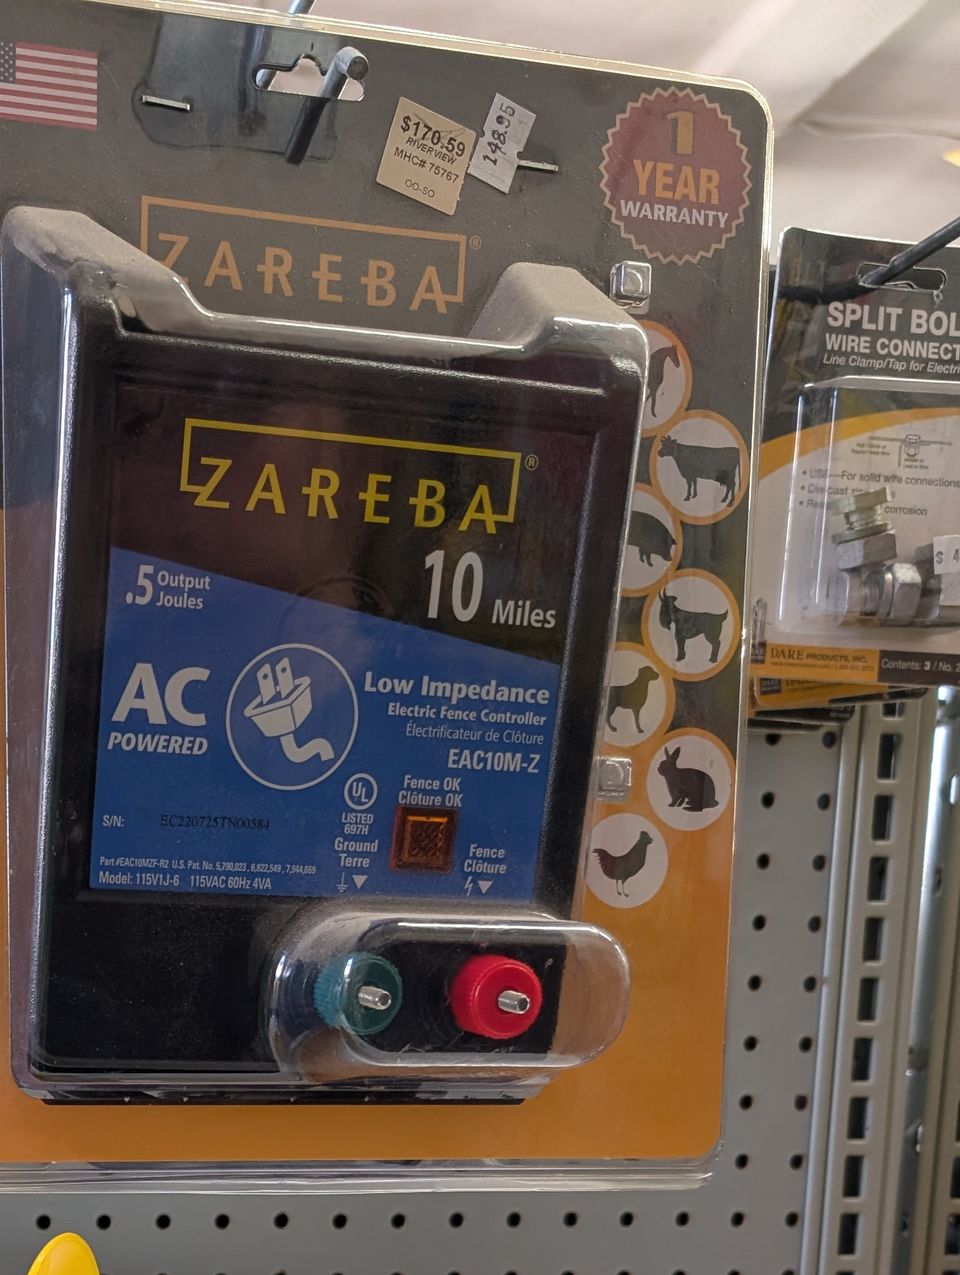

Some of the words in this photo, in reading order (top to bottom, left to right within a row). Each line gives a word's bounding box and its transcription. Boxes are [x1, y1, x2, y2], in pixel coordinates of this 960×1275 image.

[401, 115, 466, 157] $170.59
[665, 110, 695, 155] 1
[406, 137, 457, 165] RIVERVIEW
[394, 147, 427, 168] MHC#
[429, 163, 460, 184] 75767
[633, 159, 720, 205] YEAR
[620, 200, 729, 228] WARRANTY
[158, 232, 448, 314] ZAREBA
[827, 301, 902, 331] SPLIT
[825, 333, 871, 353] WIRE
[822, 353, 846, 365] Line
[847, 355, 907, 372] Clamp/Tap
[908, 359, 925, 371] for
[859, 472, 881, 482] solid
[884, 474, 903, 485] wire
[192, 456, 498, 535] ZAREBA
[884, 505, 928, 516] corrosion
[125, 564, 154, 605] .5
[157, 570, 210, 595] Output
[424, 549, 483, 622] 10
[156, 590, 203, 609] Joules
[491, 599, 556, 628] Miles
[111, 662, 210, 726] AC
[364, 671, 414, 694] Low
[421, 675, 550, 704] Impedance
[387, 702, 436, 722] Electric
[439, 705, 476, 721] Fence
[480, 708, 547, 725] Controller
[107, 731, 208, 755] POWERED
[405, 720, 482, 740] Électrificateur
[484, 728, 500, 742] de
[502, 729, 544, 745] Clôture
[447, 748, 540, 773] EAC10M-Z
[401, 774, 440, 792] Fence
[443, 777, 461, 794] OK
[398, 790, 442, 806] Clôture
[445, 793, 463, 807] OK
[102, 814, 124, 827] S/N:
[342, 812, 373, 827] LISTED
[344, 823, 369, 835] 697H
[334, 836, 378, 857] Ground
[467, 844, 505, 862] Fence
[339, 853, 370, 868] Terre
[463, 858, 507, 877] Clôture
[99, 870, 133, 884] Model:
[190, 874, 226, 889] 115VAC
[227, 876, 251, 889] 60Hz
[252, 877, 272, 890] 4VA
